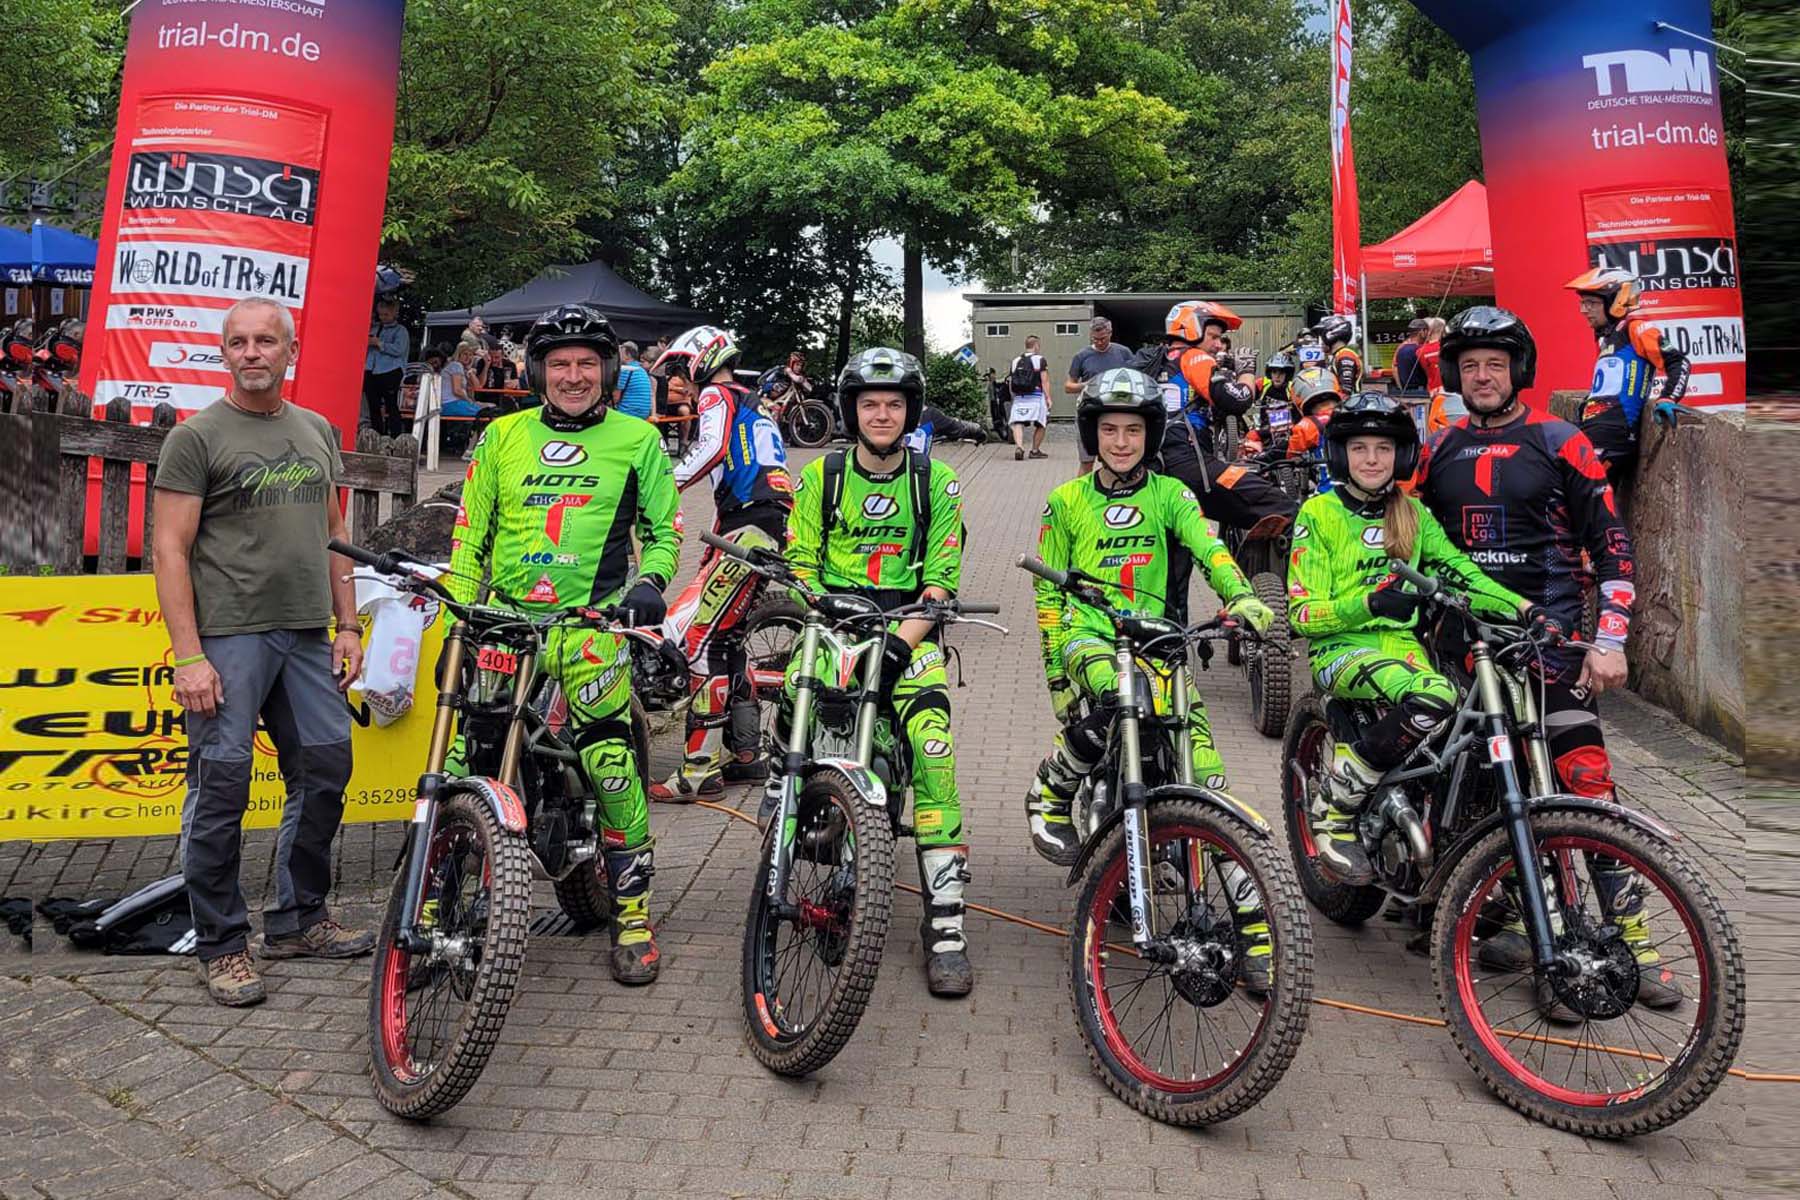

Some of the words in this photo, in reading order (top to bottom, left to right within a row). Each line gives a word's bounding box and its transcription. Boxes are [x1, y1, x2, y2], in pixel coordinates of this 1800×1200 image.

[158, 21, 321, 61] trial-dm.de
[1582, 48, 1712, 97] TDM
[189, 103, 220, 112] Partner
[1587, 95, 1638, 111] DEUTSCHE
[1591, 121, 1718, 150] trial-dm.de
[129, 194, 253, 215] WÜNSCH
[269, 206, 308, 224] AG
[1720, 276, 1736, 288] AG
[146, 307, 174, 318] PWS
[144, 318, 197, 329] OFFROAD
[1305, 350, 1321, 360] 97
[241, 460, 319, 496] Vertigo
[521, 474, 600, 488] MOTS
[869, 473, 894, 481] MOTS
[232, 486, 290, 513] FACTORY
[533, 494, 583, 506] THOMA
[1471, 511, 1493, 529] my
[851, 525, 908, 538] MOTS
[1471, 524, 1497, 542] tga
[1095, 535, 1156, 551] MOTS
[1106, 556, 1148, 567] THOMA
[479, 653, 515, 672] 401
[1126, 827, 1138, 901] DUNLOP
